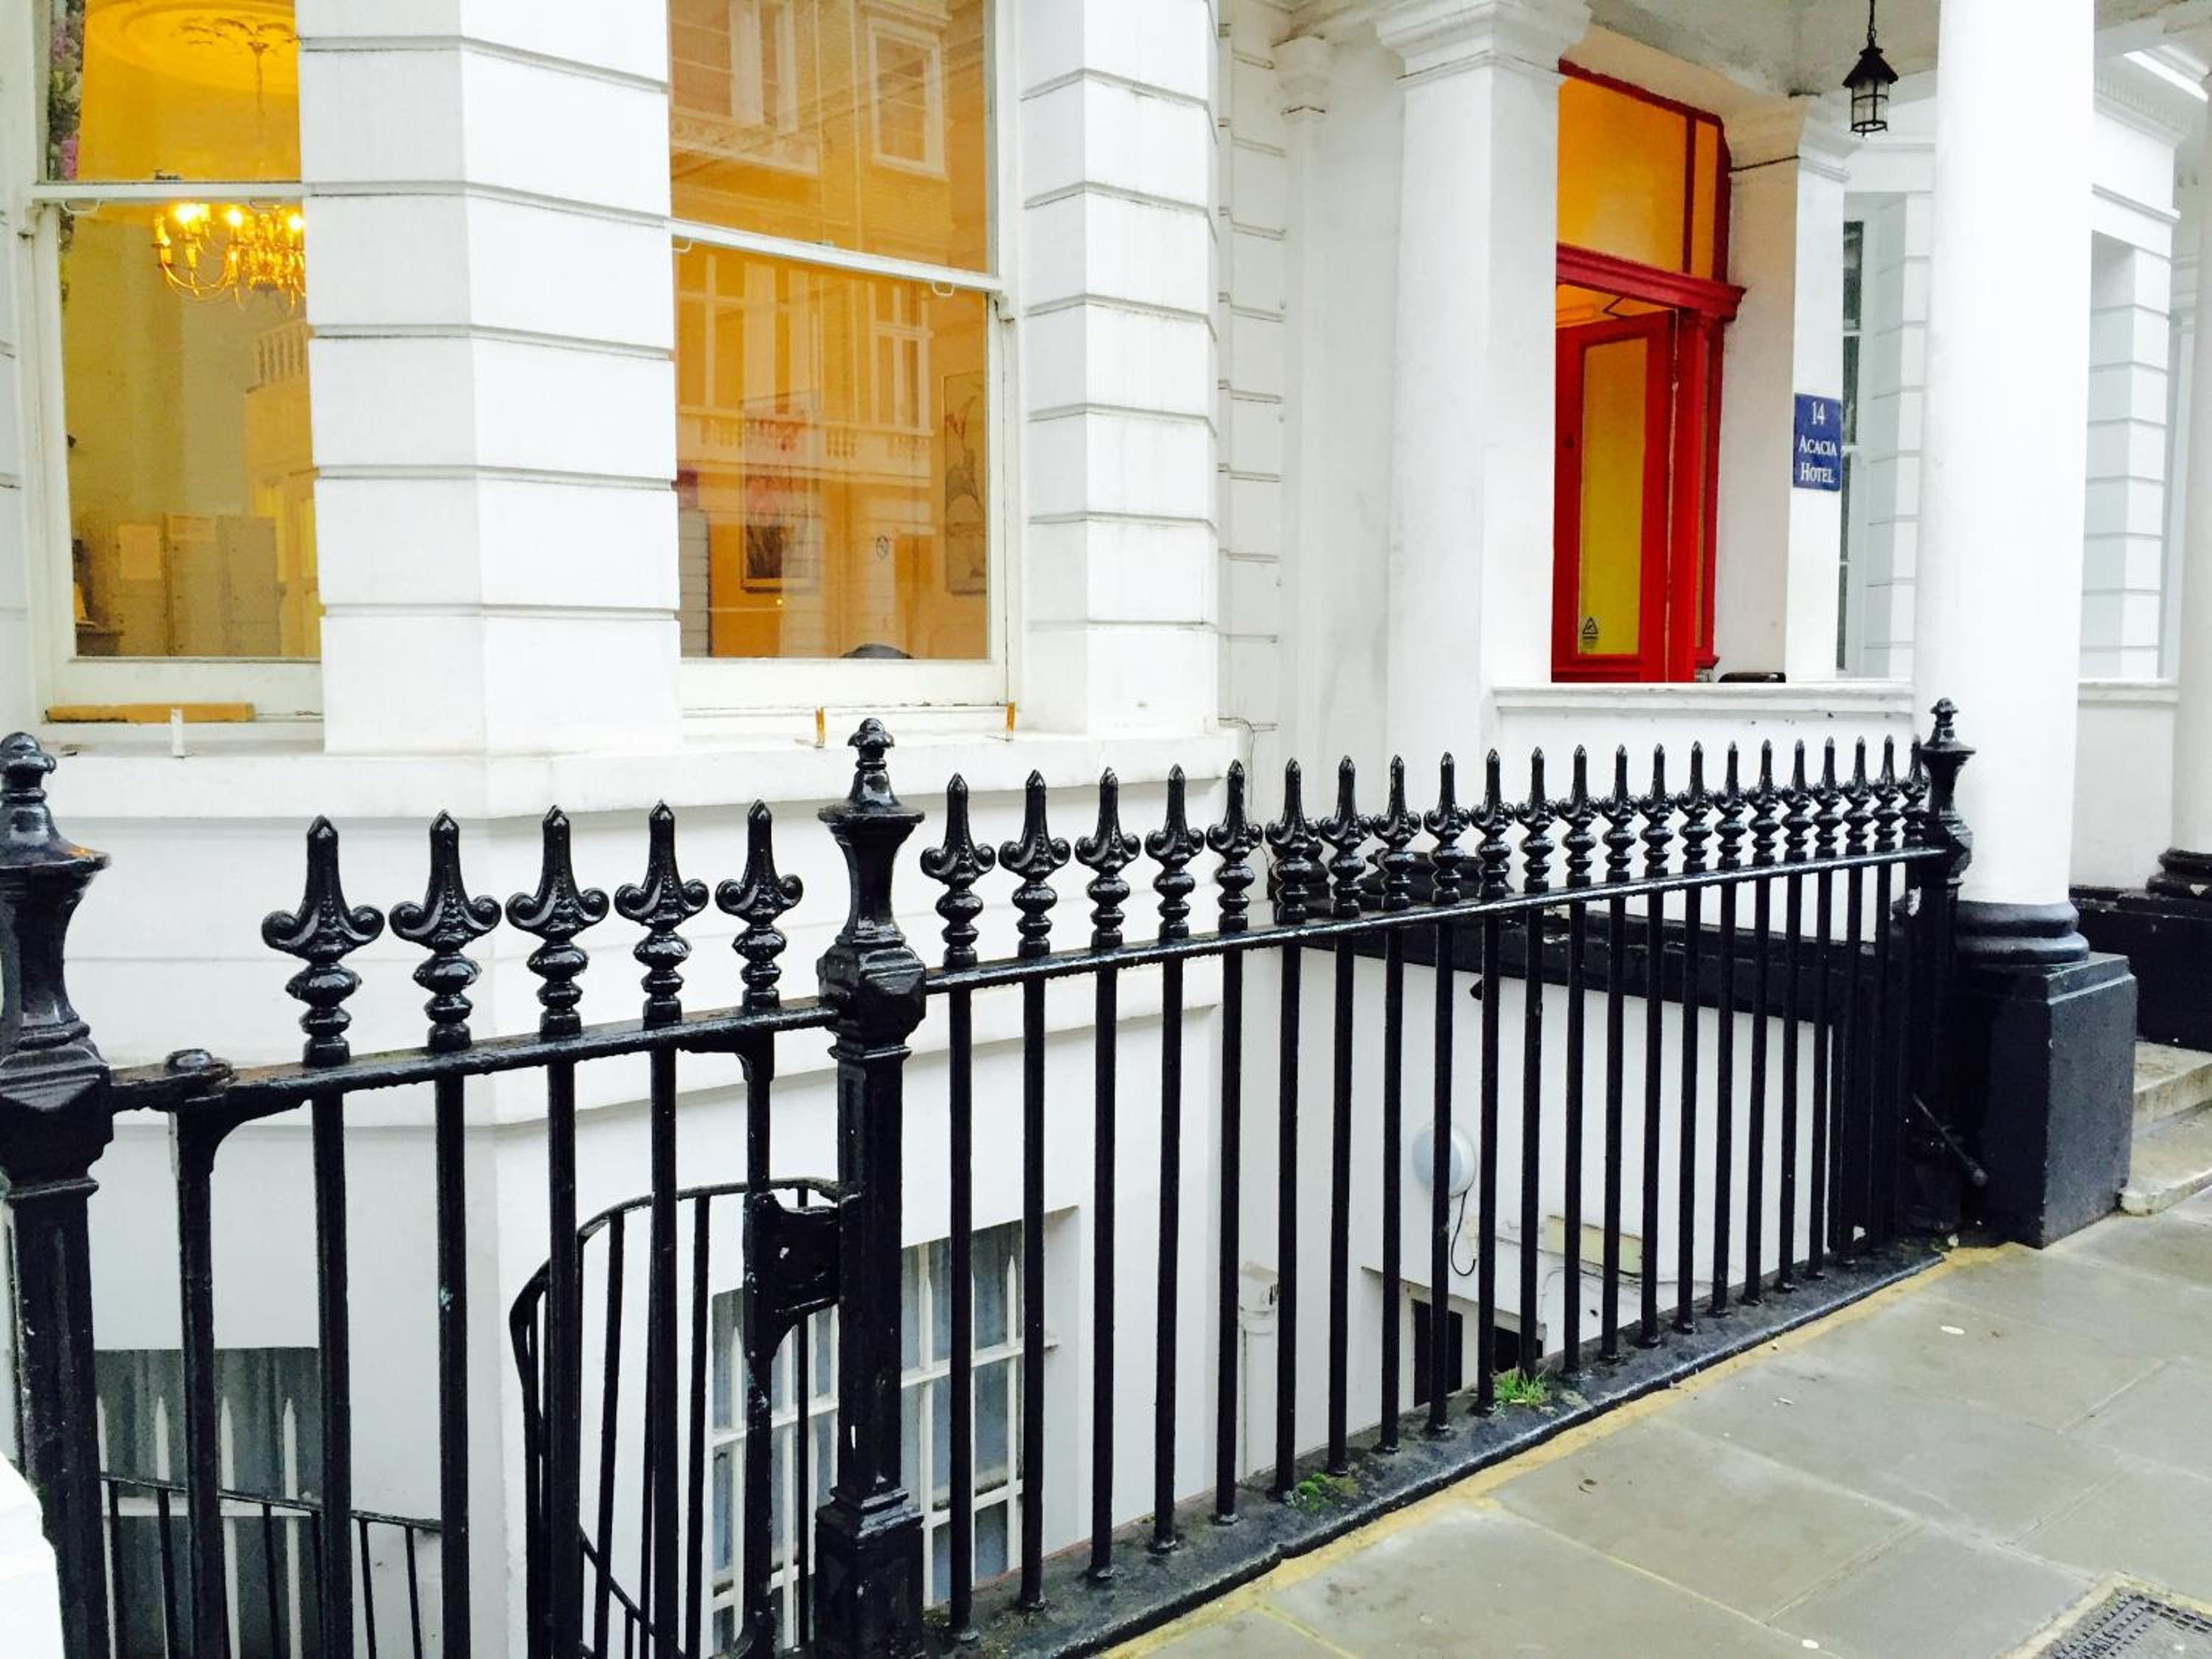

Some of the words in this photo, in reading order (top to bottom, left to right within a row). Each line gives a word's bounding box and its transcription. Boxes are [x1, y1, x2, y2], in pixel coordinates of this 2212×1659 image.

[1812, 401, 1825, 425] 14
[1799, 435, 1837, 456] ACACIA
[1801, 462, 1834, 483] HOTEL
